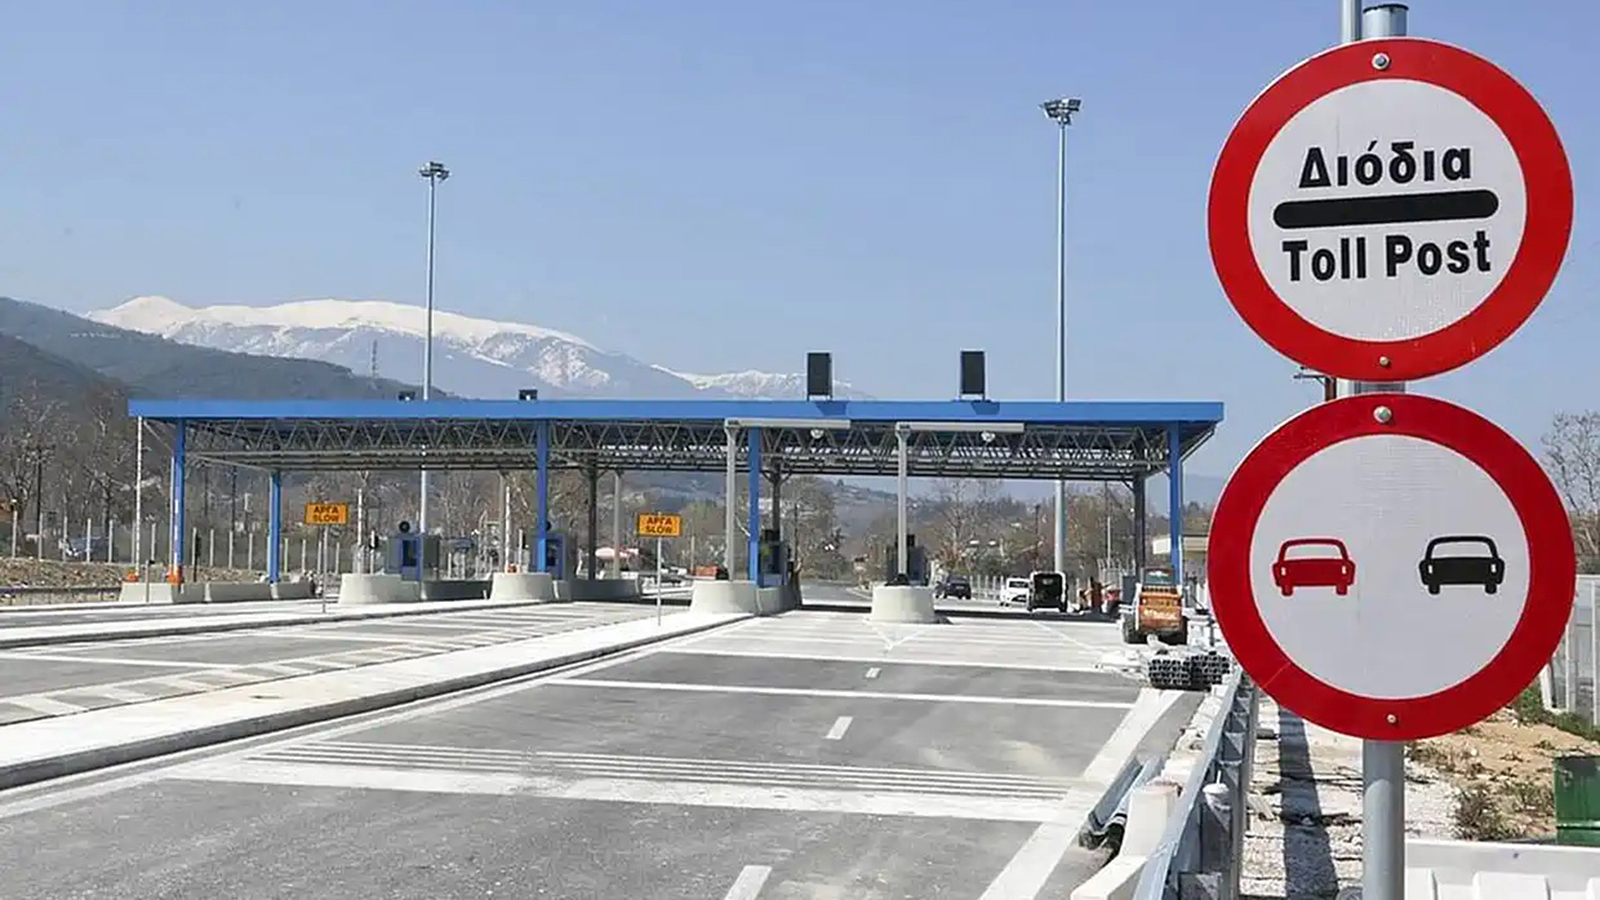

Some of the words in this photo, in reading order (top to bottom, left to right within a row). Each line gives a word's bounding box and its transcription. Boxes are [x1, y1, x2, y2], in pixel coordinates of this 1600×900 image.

[1299, 140, 1471, 188] Διόδια
[1282, 237, 1366, 282] Toll
[1385, 231, 1491, 277] Post
[645, 526, 672, 534] SLOW
